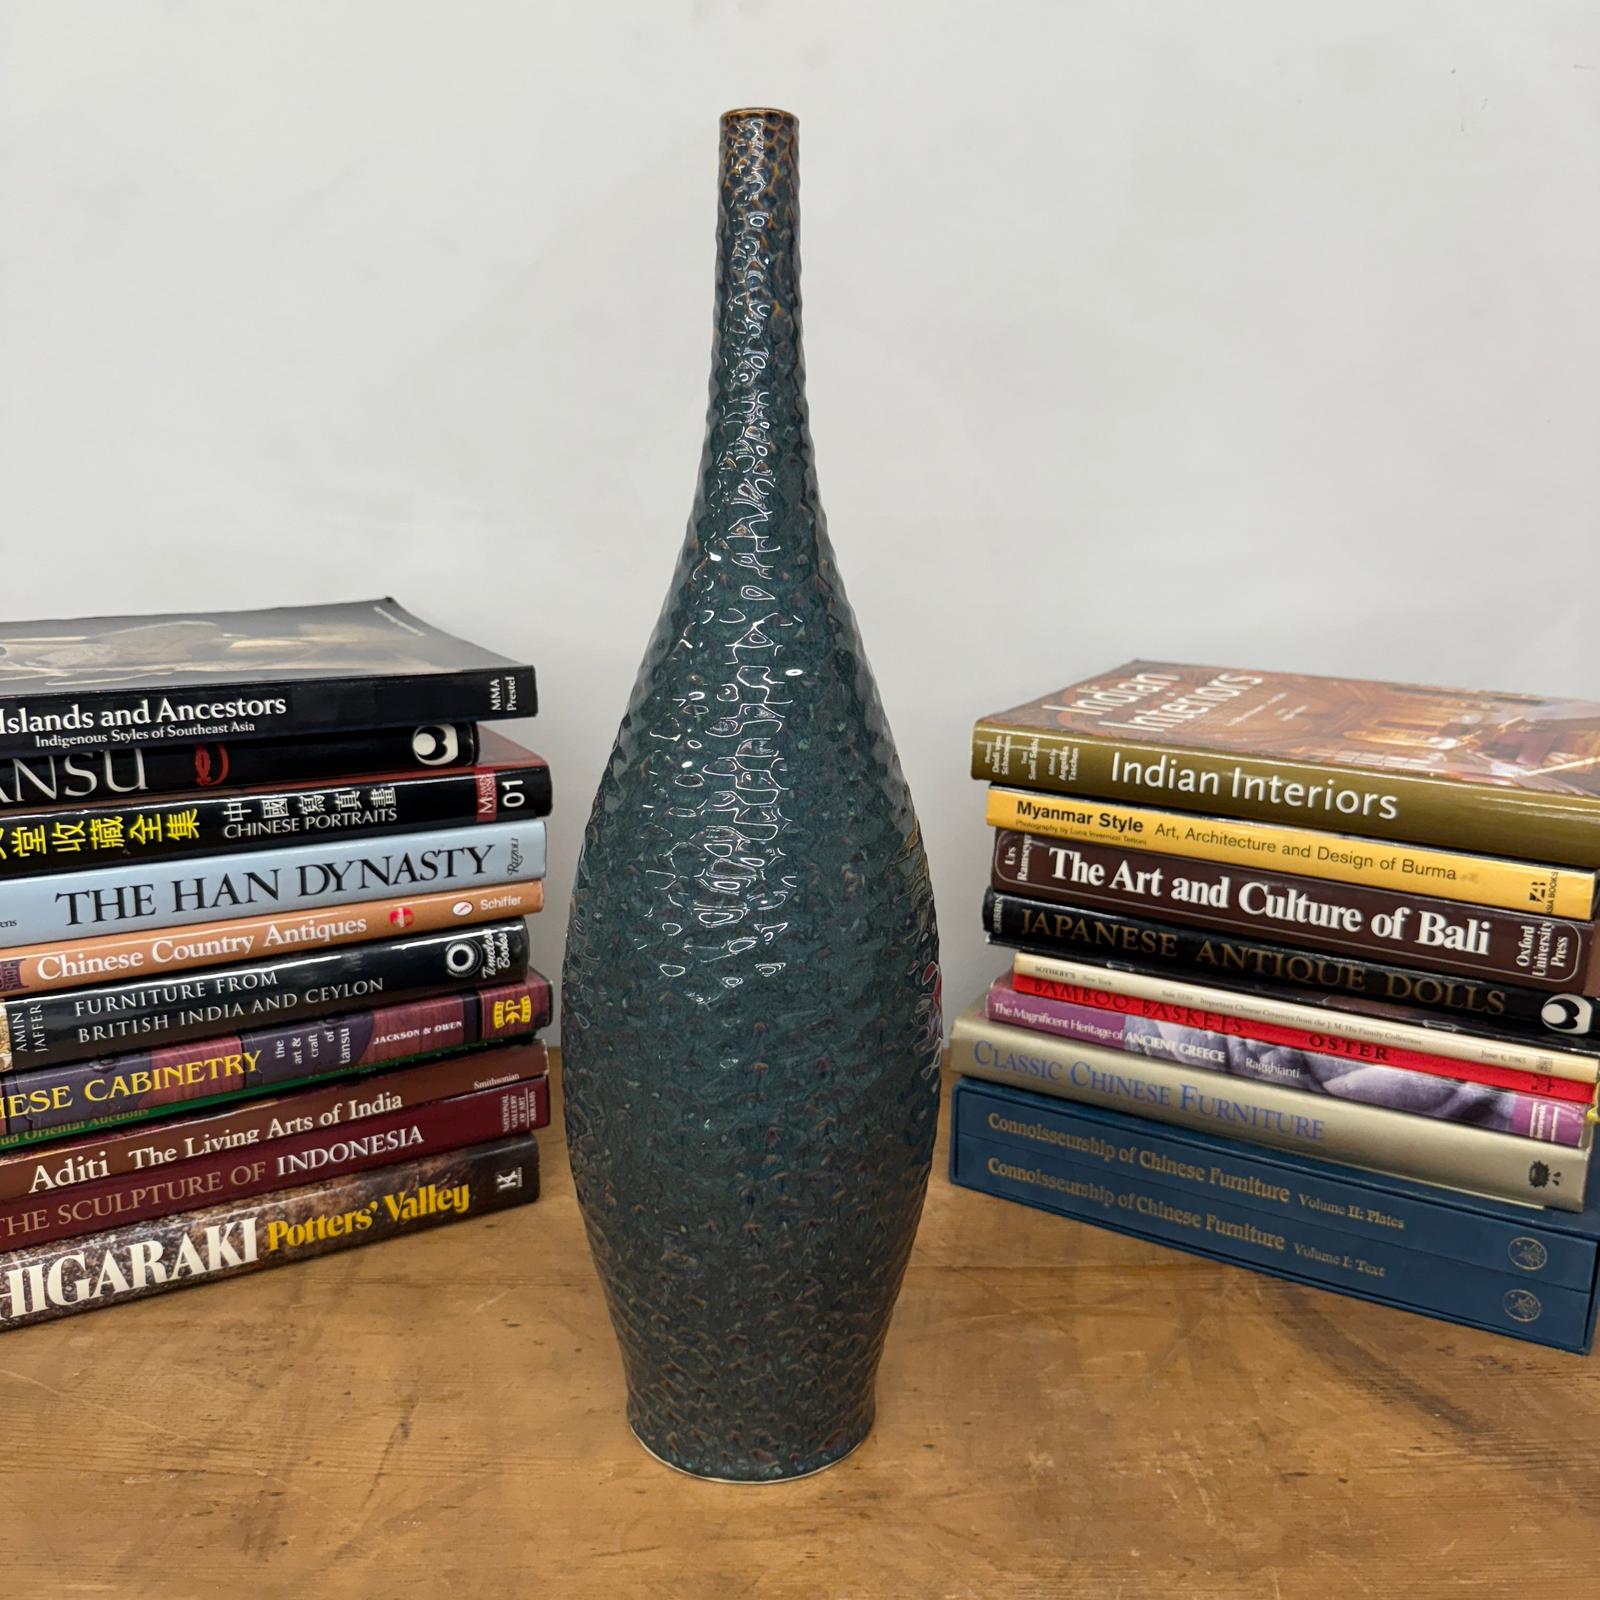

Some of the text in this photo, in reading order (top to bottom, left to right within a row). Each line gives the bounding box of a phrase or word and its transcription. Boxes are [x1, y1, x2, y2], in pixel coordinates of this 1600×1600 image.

[0, 697, 287, 734] Islands and Ancestors
[489, 679, 502, 711] MMA
[505, 676, 517, 711] Prestel
[1042, 671, 1180, 716] Indian
[1098, 673, 1263, 733] Interiors
[35, 721, 255, 748] Indigenous Styles of Southeast Asia
[0, 748, 149, 803] NSU
[1068, 747, 1079, 781] Taschen
[1111, 751, 1398, 820] Indian Interiors
[502, 780, 525, 808] 01
[225, 808, 397, 838] CHINESE PORTRAITS
[1016, 800, 1457, 881] Myanmar Style Art, Architecture and Design of Burma
[1004, 845, 1016, 865] Urs
[55, 844, 495, 926] THE HAN DYNASTY
[1048, 847, 1491, 956] The Art and Culture of Bali
[37, 952, 144, 980] Chinese
[151, 935, 255, 964] Country
[263, 918, 367, 947] Antiques
[480, 895, 522, 910] Schiffer
[495, 932, 510, 968] Books
[1516, 925, 1536, 967] Oxford
[1532, 920, 1555, 977] University
[1550, 936, 1569, 968] Press
[1020, 908, 1505, 1016] JAPANESE ANTIQUE DOLLS
[74, 970, 279, 1017] FURNITURE FROM
[78, 977, 384, 1044] BRITISH INDIA AND CEYLON
[12, 1011, 28, 1052] AMIN
[31, 1004, 48, 1053] JAFFER
[326, 1030, 335, 1042] of
[373, 1020, 463, 1045] JACKSON & OWEN
[994, 1003, 1300, 1079] The Magnificent Heritage of ANCIENT GREECE Ragghianti
[1034, 979, 1390, 1062] BAMBOO BASKETS OSTER
[275, 1040, 285, 1058] the
[293, 1036, 303, 1065] art &
[308, 1033, 319, 1058] craft
[339, 1027, 350, 1064] tansu
[84, 1050, 261, 1101] CABINETRY
[473, 1073, 520, 1090] Smithsonian
[973, 1039, 1325, 1141] CLASSIC CHINESE FURNITURE
[28, 1091, 403, 1193] Aditi The Living Arts of India
[58, 1171, 223, 1225] SCULPTURE
[230, 1161, 266, 1186] OF
[276, 1125, 424, 1176] INDONESIA
[987, 1112, 1405, 1230] Connoisseurship of Chinese Furniture Volume II: Plates
[384, 1183, 470, 1222] Valley
[987, 1157, 1114, 1207] Connoisseurship
[1118, 1190, 1136, 1209] of
[1136, 1196, 1201, 1229] Chinese
[1206, 1213, 1286, 1250] Furniture
[1294, 1242, 1341, 1266] Volume
[1355, 1258, 1386, 1278] Text
